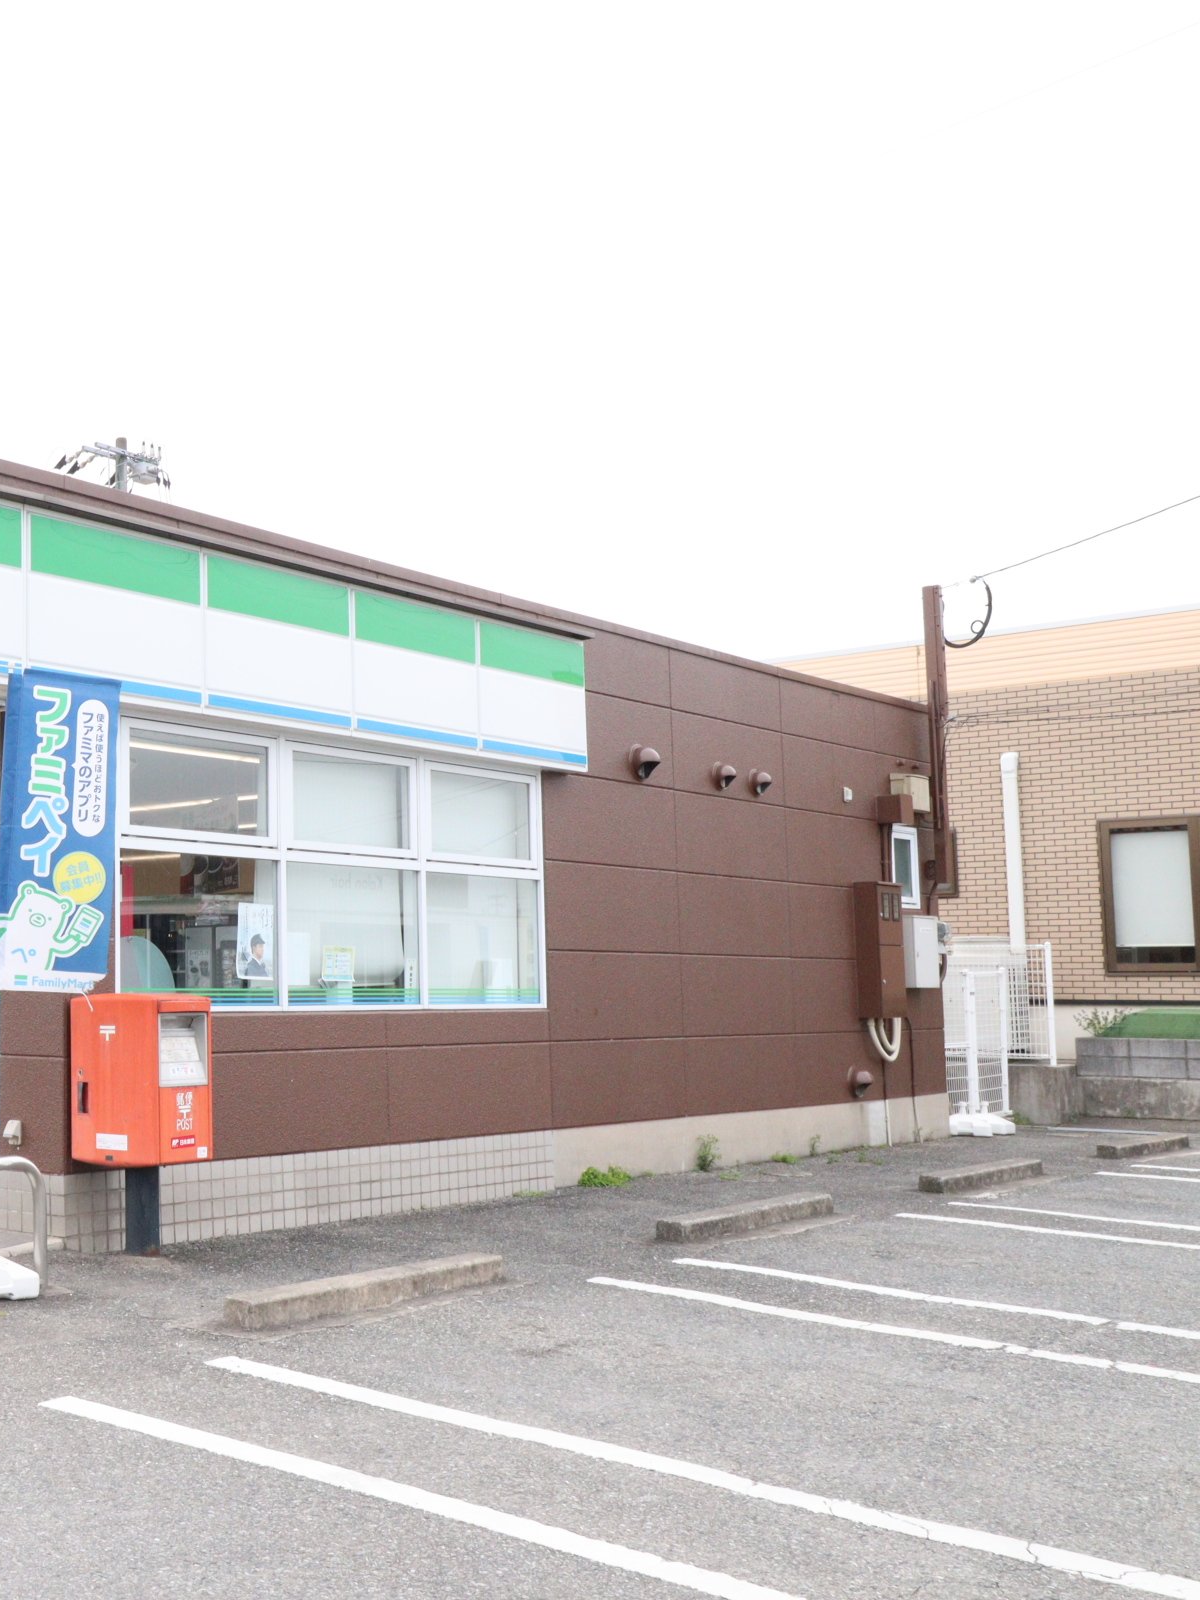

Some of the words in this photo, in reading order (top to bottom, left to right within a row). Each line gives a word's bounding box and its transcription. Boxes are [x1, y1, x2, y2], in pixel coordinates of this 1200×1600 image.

[77, 712, 94, 822] ファミマのアプリ
[92, 713, 105, 823] 使えば使うほどおトクな
[21, 686, 71, 876] ファミペイ
[65, 860, 90, 876] 会員
[60, 871, 102, 893] 募集中!!
[10, 947, 37, 963] ペ
[31, 975, 93, 990] FamilyMart
[176, 1092, 193, 1106] 郵便
[176, 1118, 193, 1130] POST
